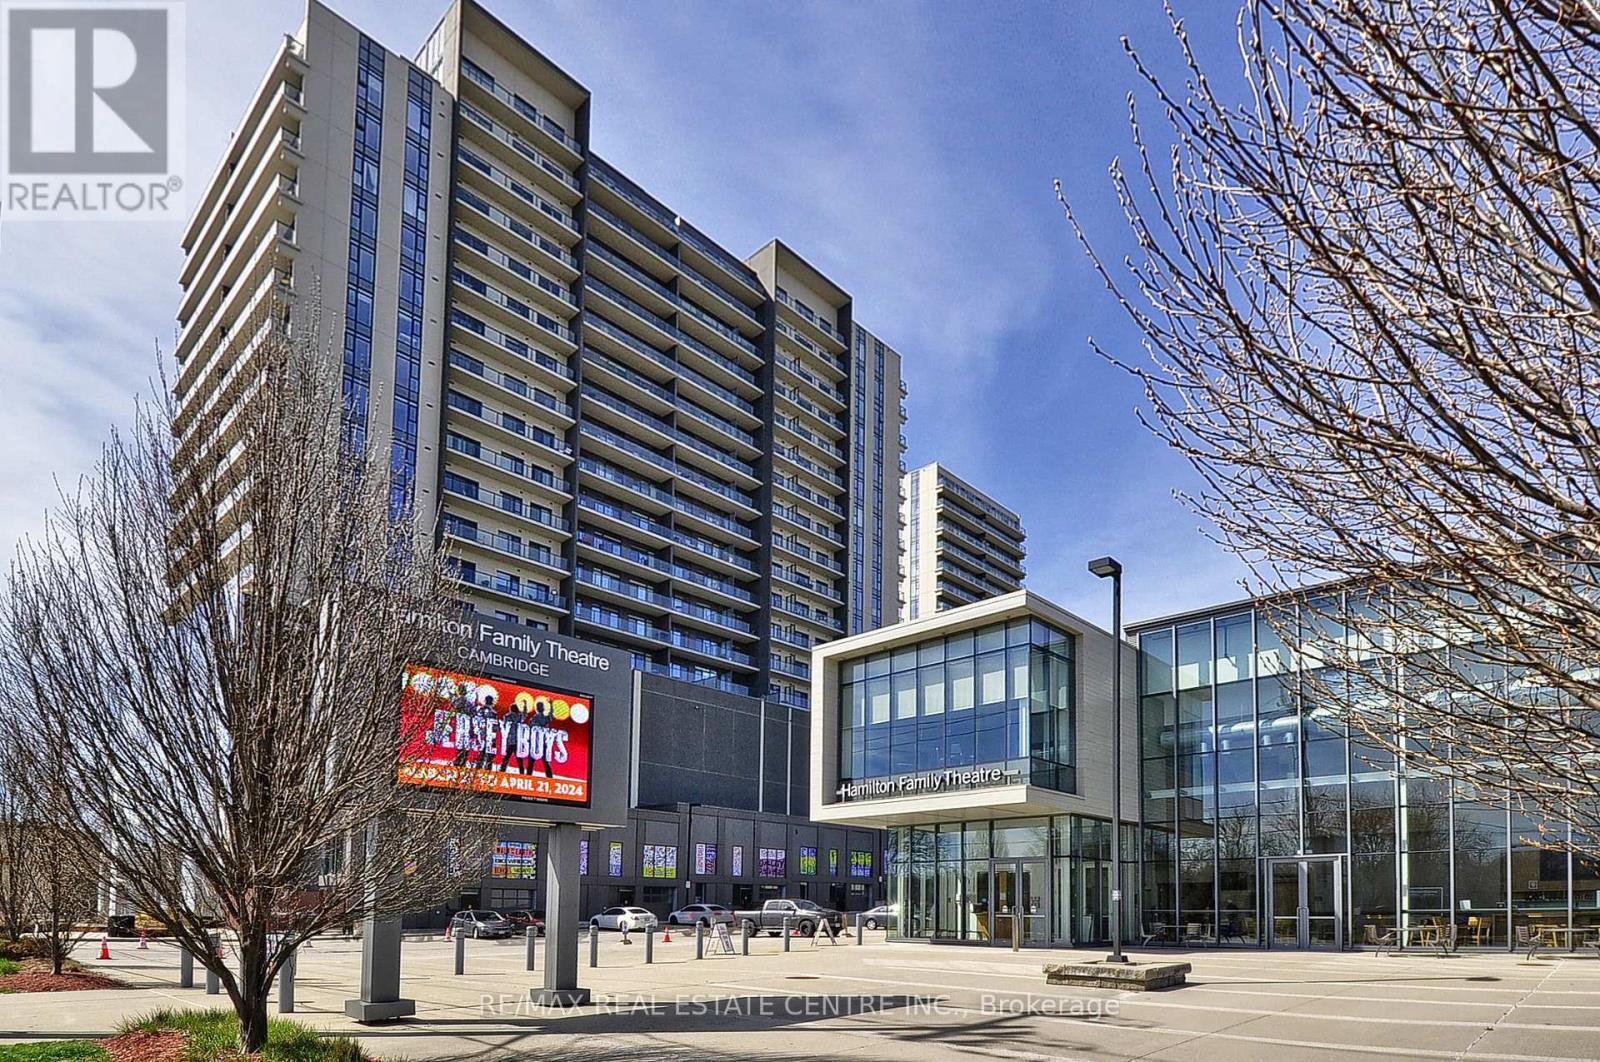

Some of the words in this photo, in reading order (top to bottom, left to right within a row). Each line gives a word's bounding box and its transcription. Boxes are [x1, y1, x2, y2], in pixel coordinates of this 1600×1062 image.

[398, 608, 473, 639] amilton
[479, 623, 542, 658] Family
[545, 640, 610, 671] Theatre
[457, 646, 550, 677] CAMBRIDGE
[516, 722, 569, 764] BOYS
[500, 776, 534, 792] APRIL
[536, 781, 552, 795] 21,
[554, 782, 584, 796] 2024
[841, 779, 895, 798] Hamilton
[898, 773, 943, 792] Family
[944, 767, 1001, 786] Theatre
